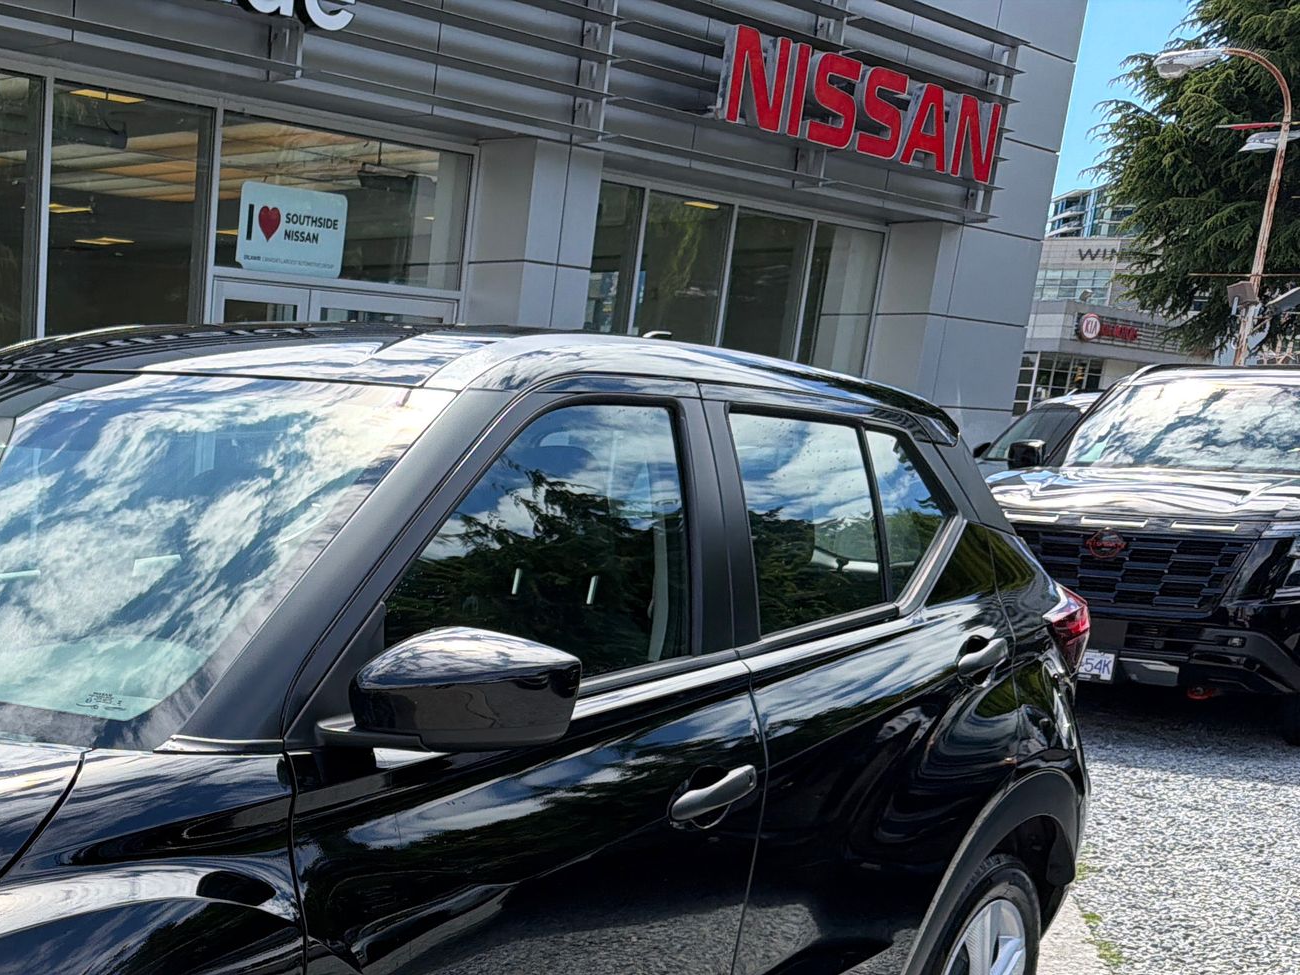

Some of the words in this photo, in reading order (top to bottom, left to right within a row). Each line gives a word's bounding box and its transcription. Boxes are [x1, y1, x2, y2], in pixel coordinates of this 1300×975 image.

[724, 24, 1003, 185] NISSAN
[285, 212, 339, 230] SOUTHSIDE
[283, 229, 319, 244] NISSAN
